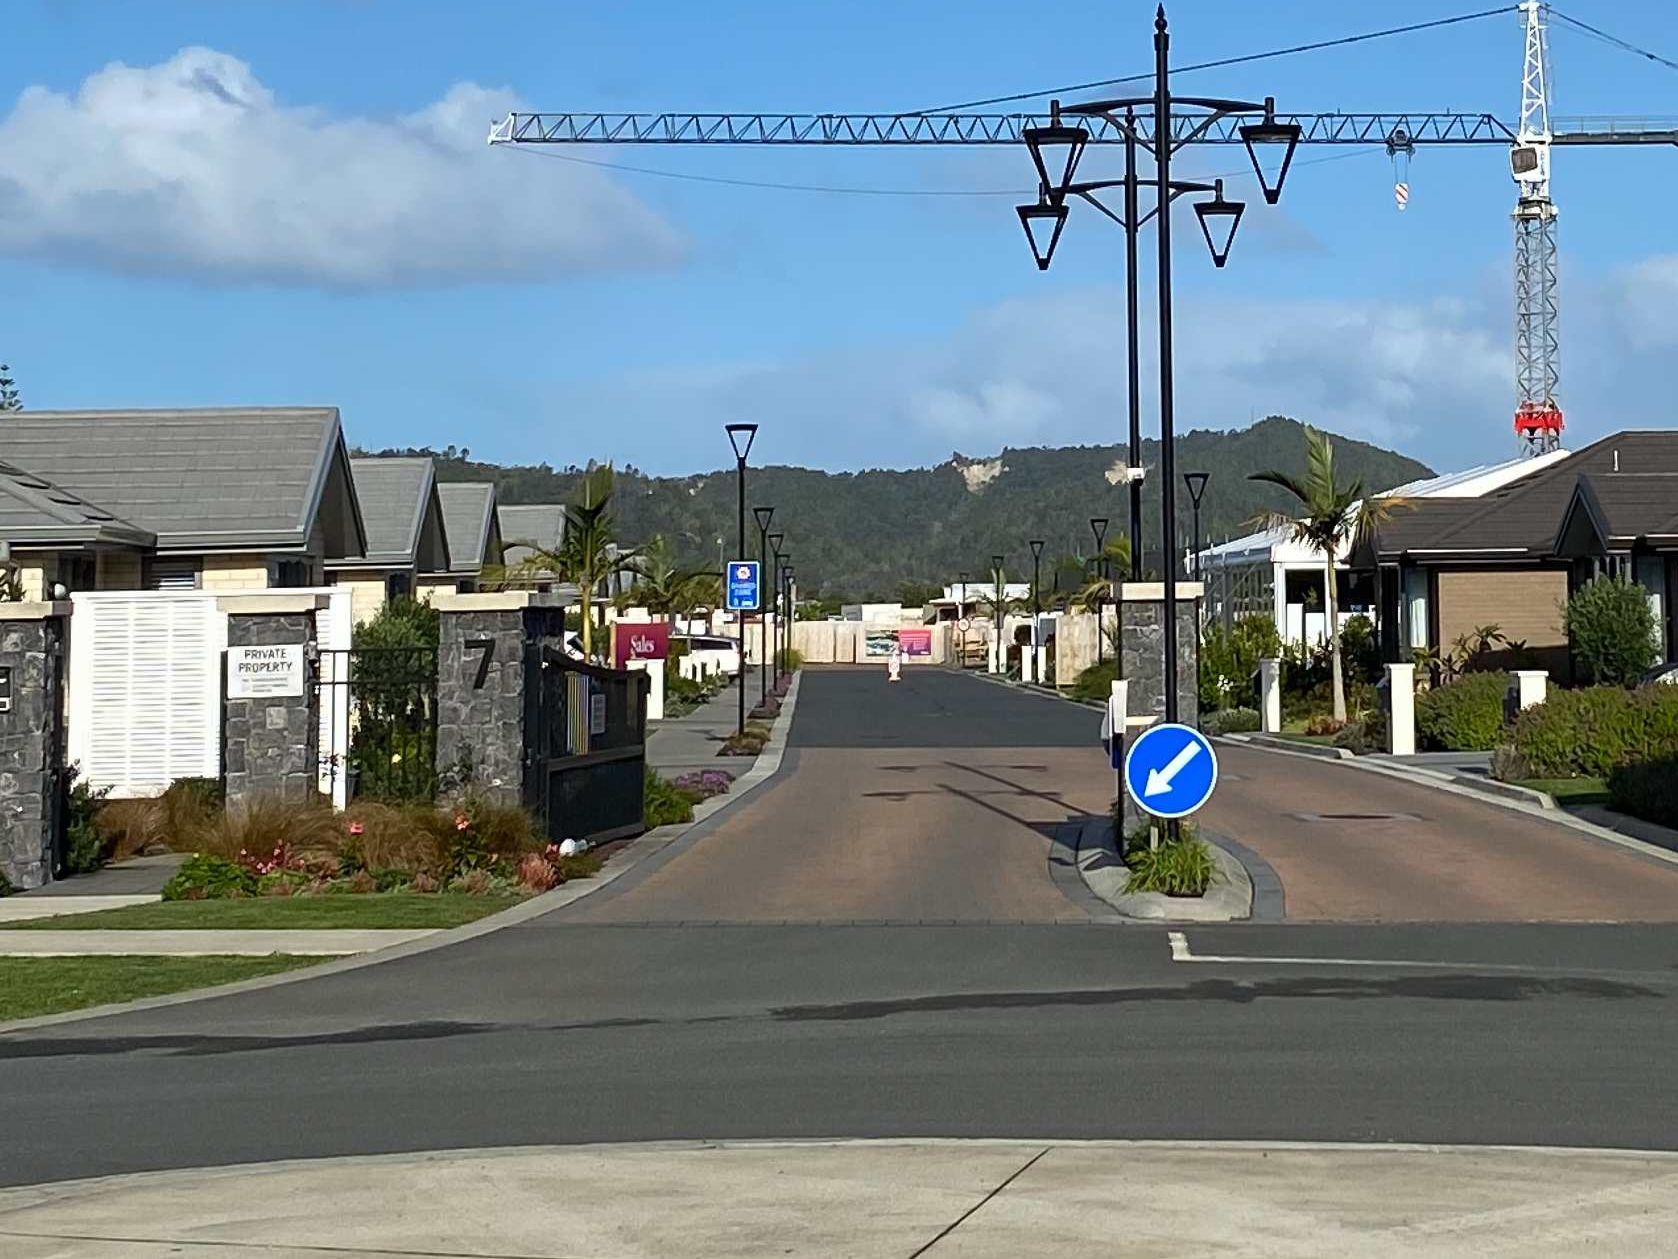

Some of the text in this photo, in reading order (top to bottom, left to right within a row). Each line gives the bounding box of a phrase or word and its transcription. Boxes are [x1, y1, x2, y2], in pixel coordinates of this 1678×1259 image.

[244, 648, 287, 659] PRIVATE
[238, 662, 293, 673] PROPERTY
[464, 639, 496, 689] 7
